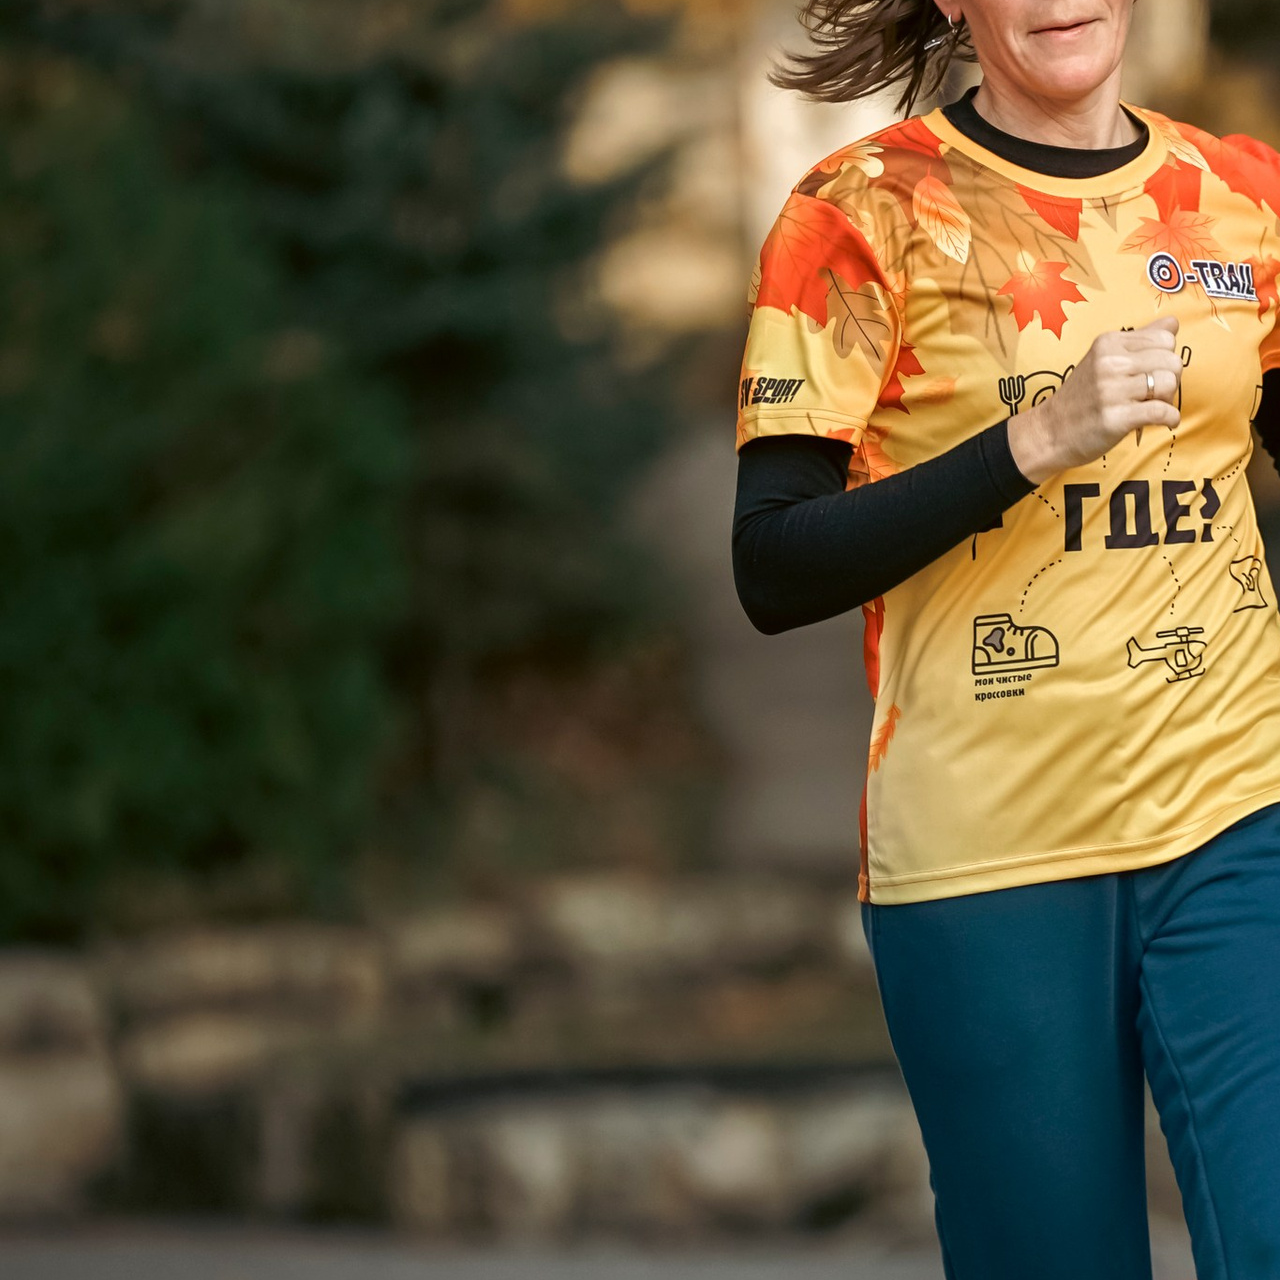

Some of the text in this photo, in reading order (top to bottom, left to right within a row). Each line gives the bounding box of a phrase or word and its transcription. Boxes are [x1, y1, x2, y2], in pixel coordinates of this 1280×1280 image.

[753, 376, 806, 397] SPORT
[974, 673, 1033, 687] мои чистые
[974, 687, 1026, 703] кроссовки
